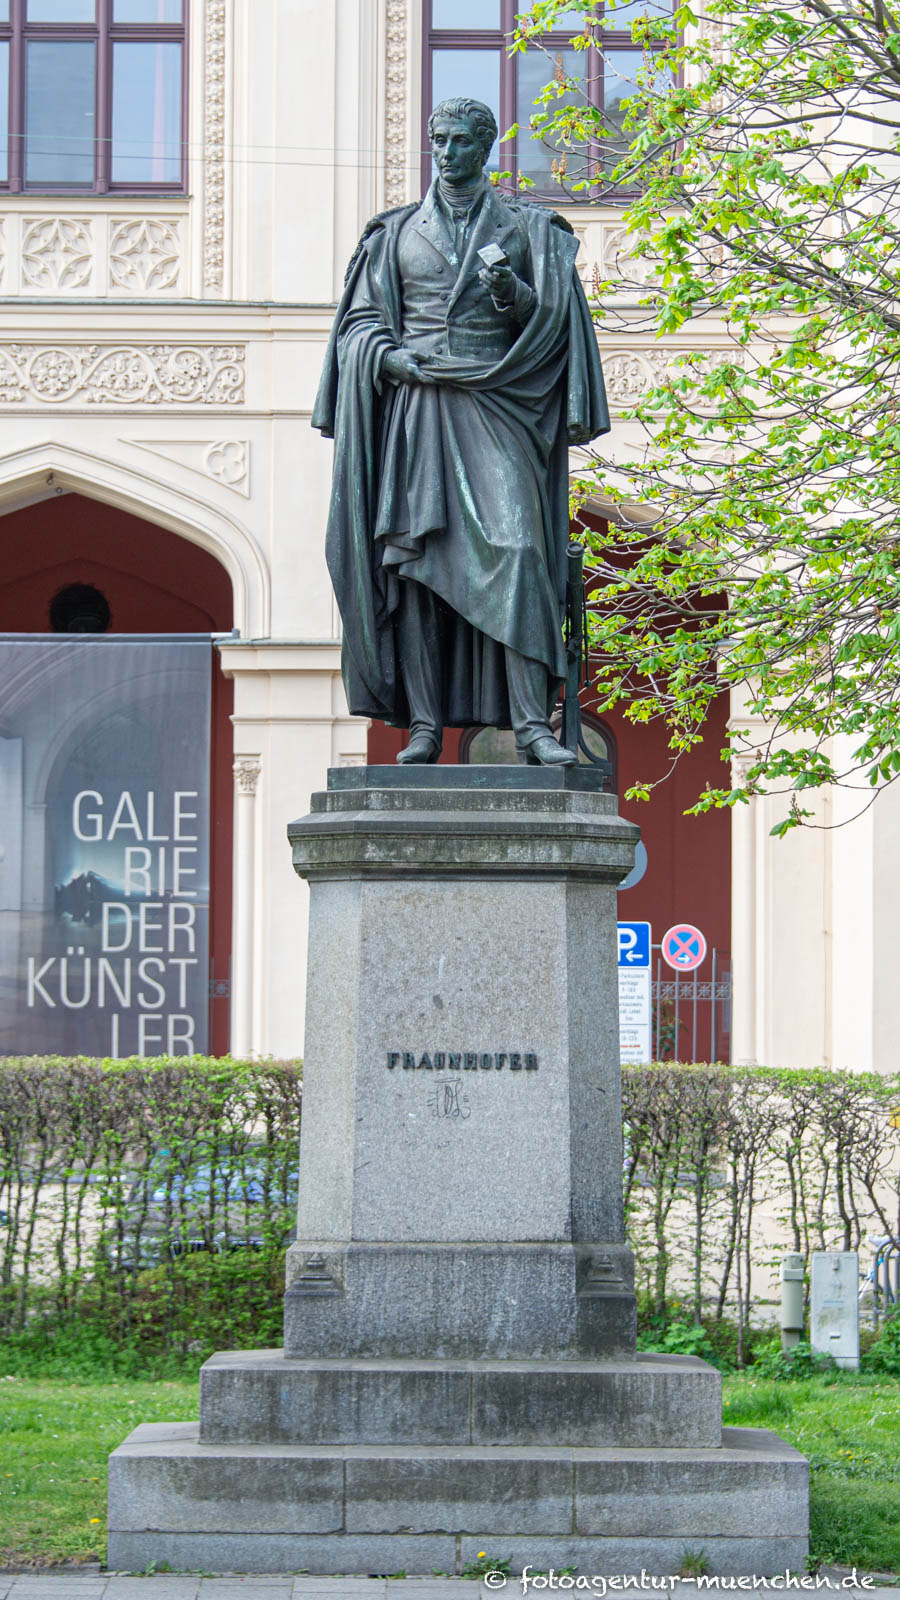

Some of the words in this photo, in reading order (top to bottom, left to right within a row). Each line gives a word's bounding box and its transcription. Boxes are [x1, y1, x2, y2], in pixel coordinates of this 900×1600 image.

[72, 790, 198, 841] GALE
[124, 847, 197, 897] RIE
[102, 902, 195, 952] DER
[617, 928, 637, 962] P
[27, 946, 198, 1008] KÜNST
[387, 1052, 539, 1071] FRAUNHOFER
